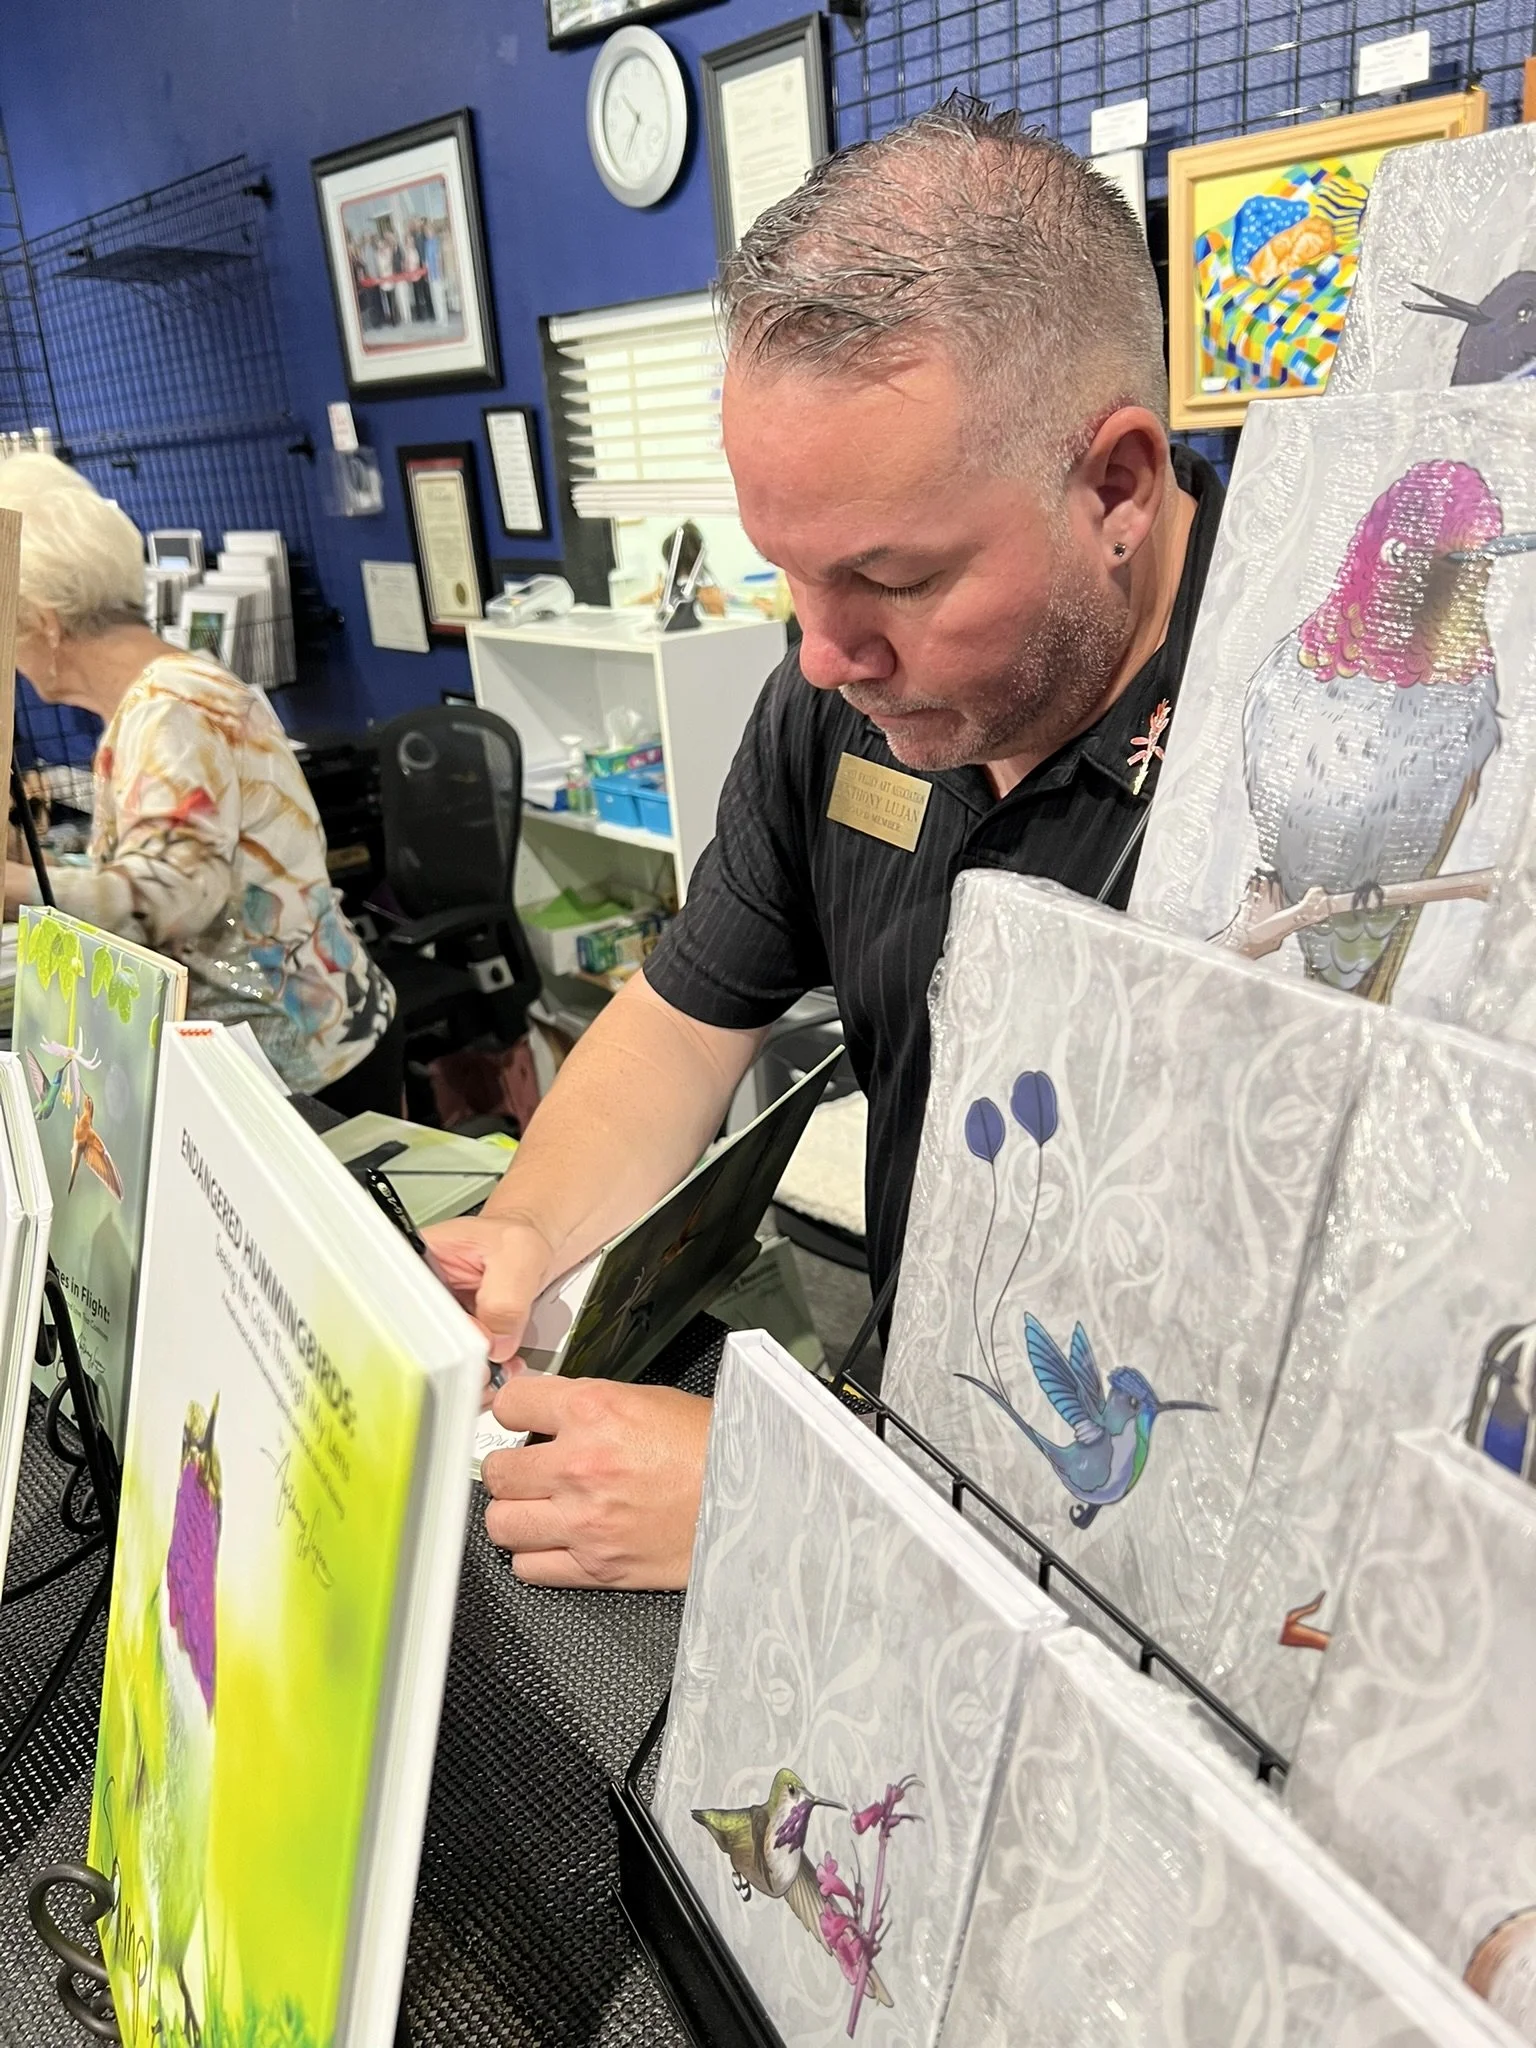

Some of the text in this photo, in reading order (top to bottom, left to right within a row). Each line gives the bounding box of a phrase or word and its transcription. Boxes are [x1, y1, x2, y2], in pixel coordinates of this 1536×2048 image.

[884, 799, 920, 823] LUJAN
[181, 1127, 243, 1249] ENDANGERED
[71, 1276, 80, 1298] in
[81, 1285, 111, 1324] Flight:
[272, 1328, 307, 1407] Through
[308, 1390, 326, 1445] My
